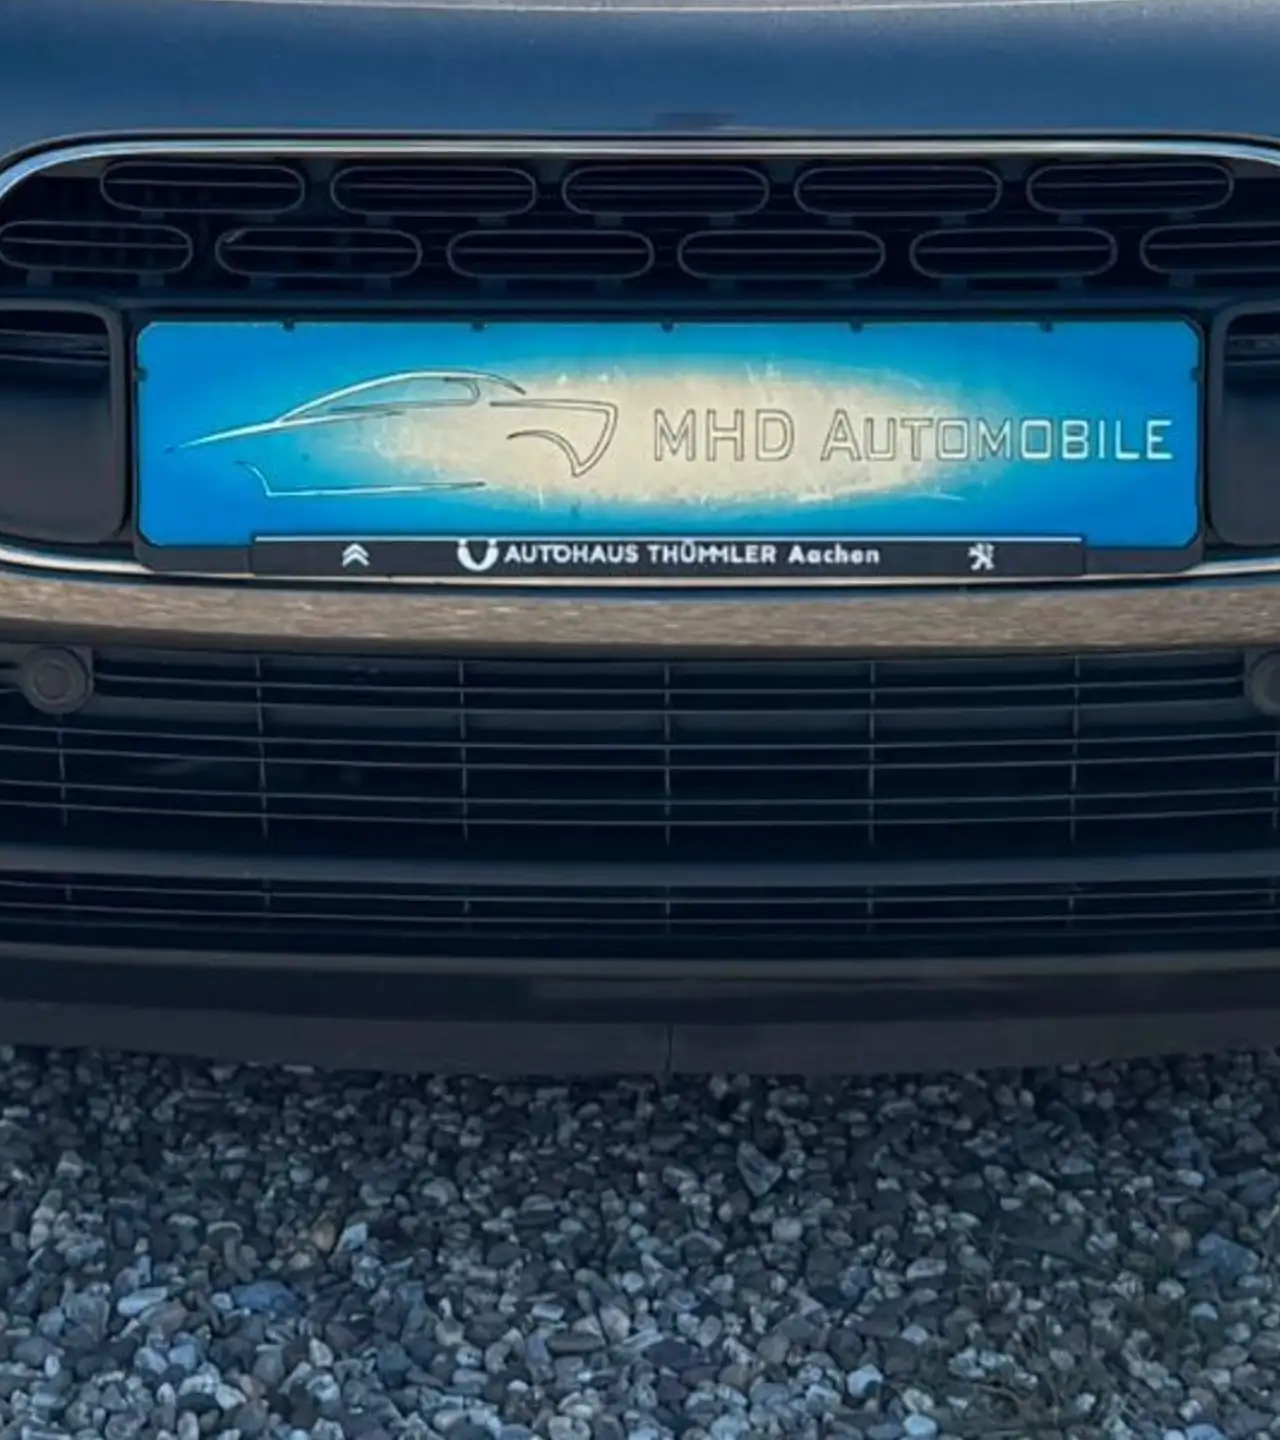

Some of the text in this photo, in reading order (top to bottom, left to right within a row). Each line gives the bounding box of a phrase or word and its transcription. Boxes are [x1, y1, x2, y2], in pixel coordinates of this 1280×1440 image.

[653, 408, 795, 463] MHD
[503, 539, 880, 565] AUTOHAUS THÜMMLER Aachen
